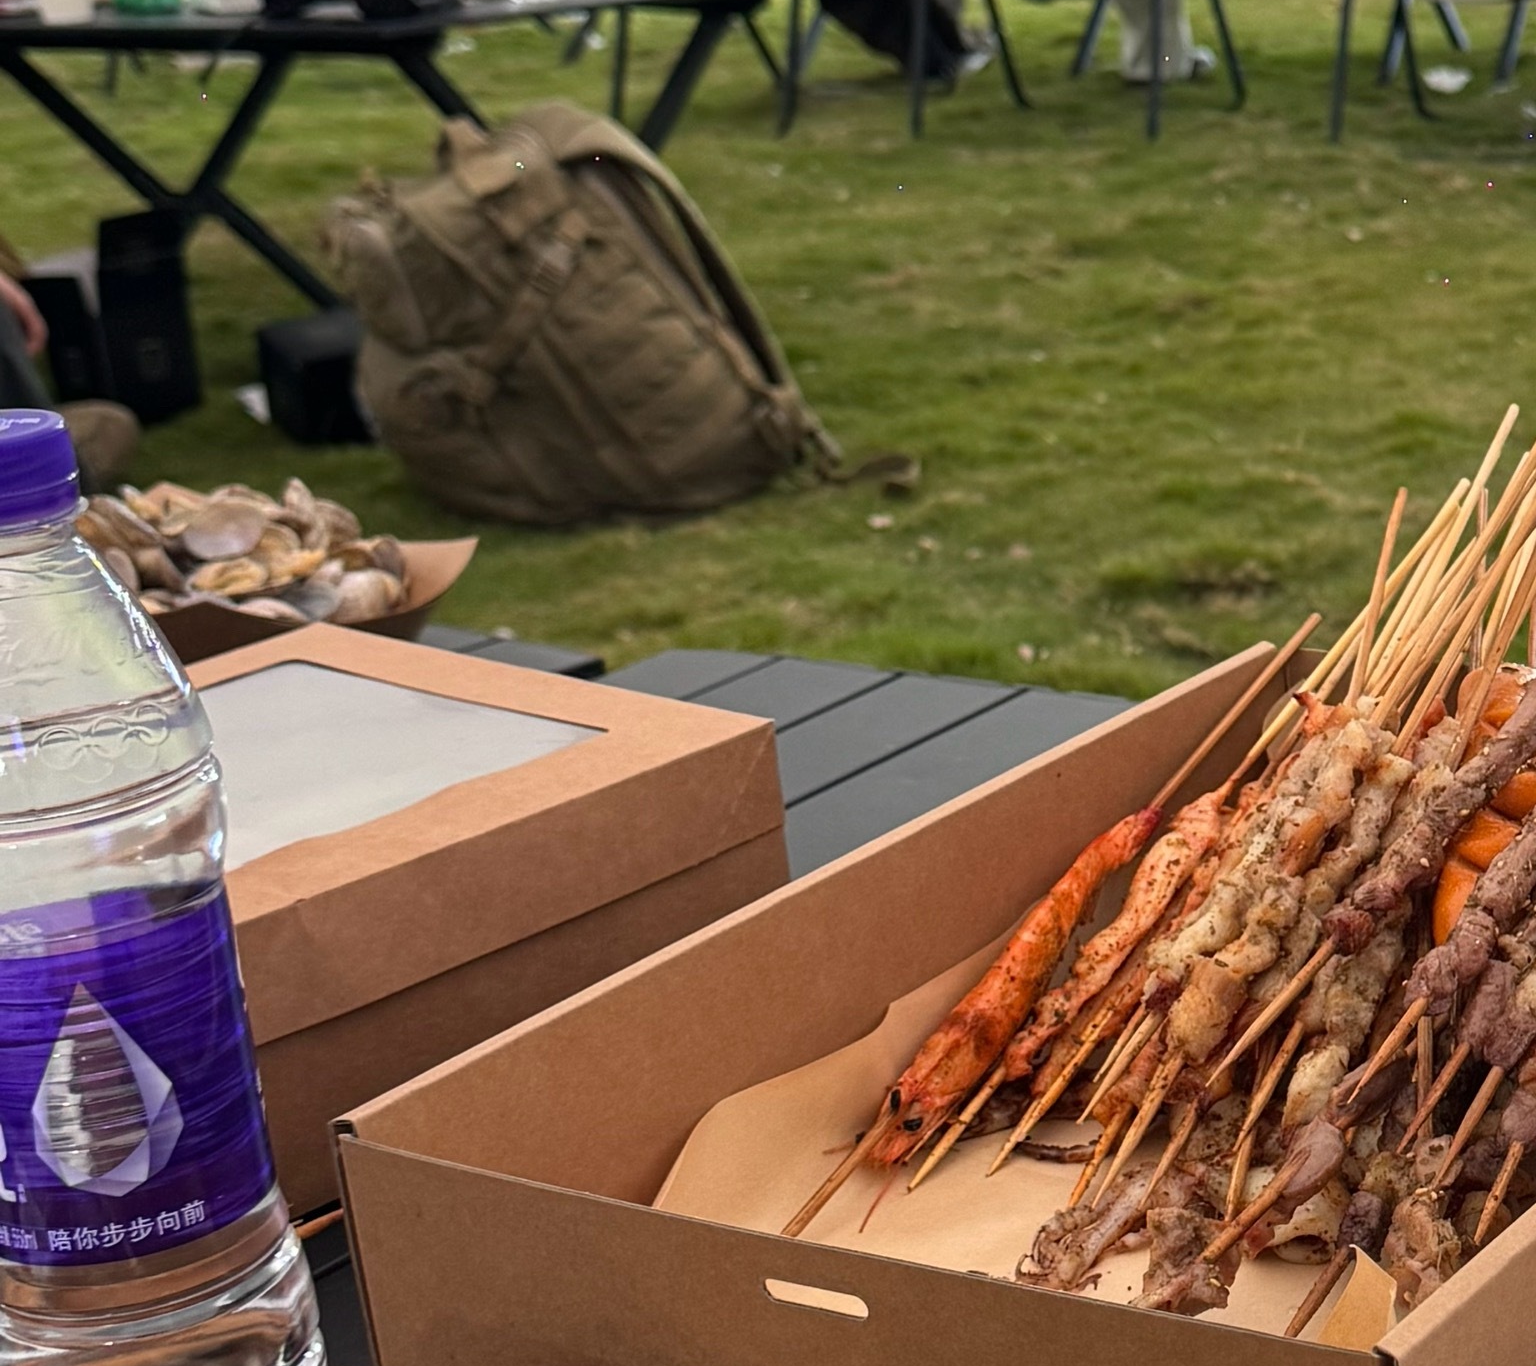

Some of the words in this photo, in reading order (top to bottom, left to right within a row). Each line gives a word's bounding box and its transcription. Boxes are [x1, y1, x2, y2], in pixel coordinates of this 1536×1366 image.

[47, 1200, 206, 1252] 陪你步步向前
